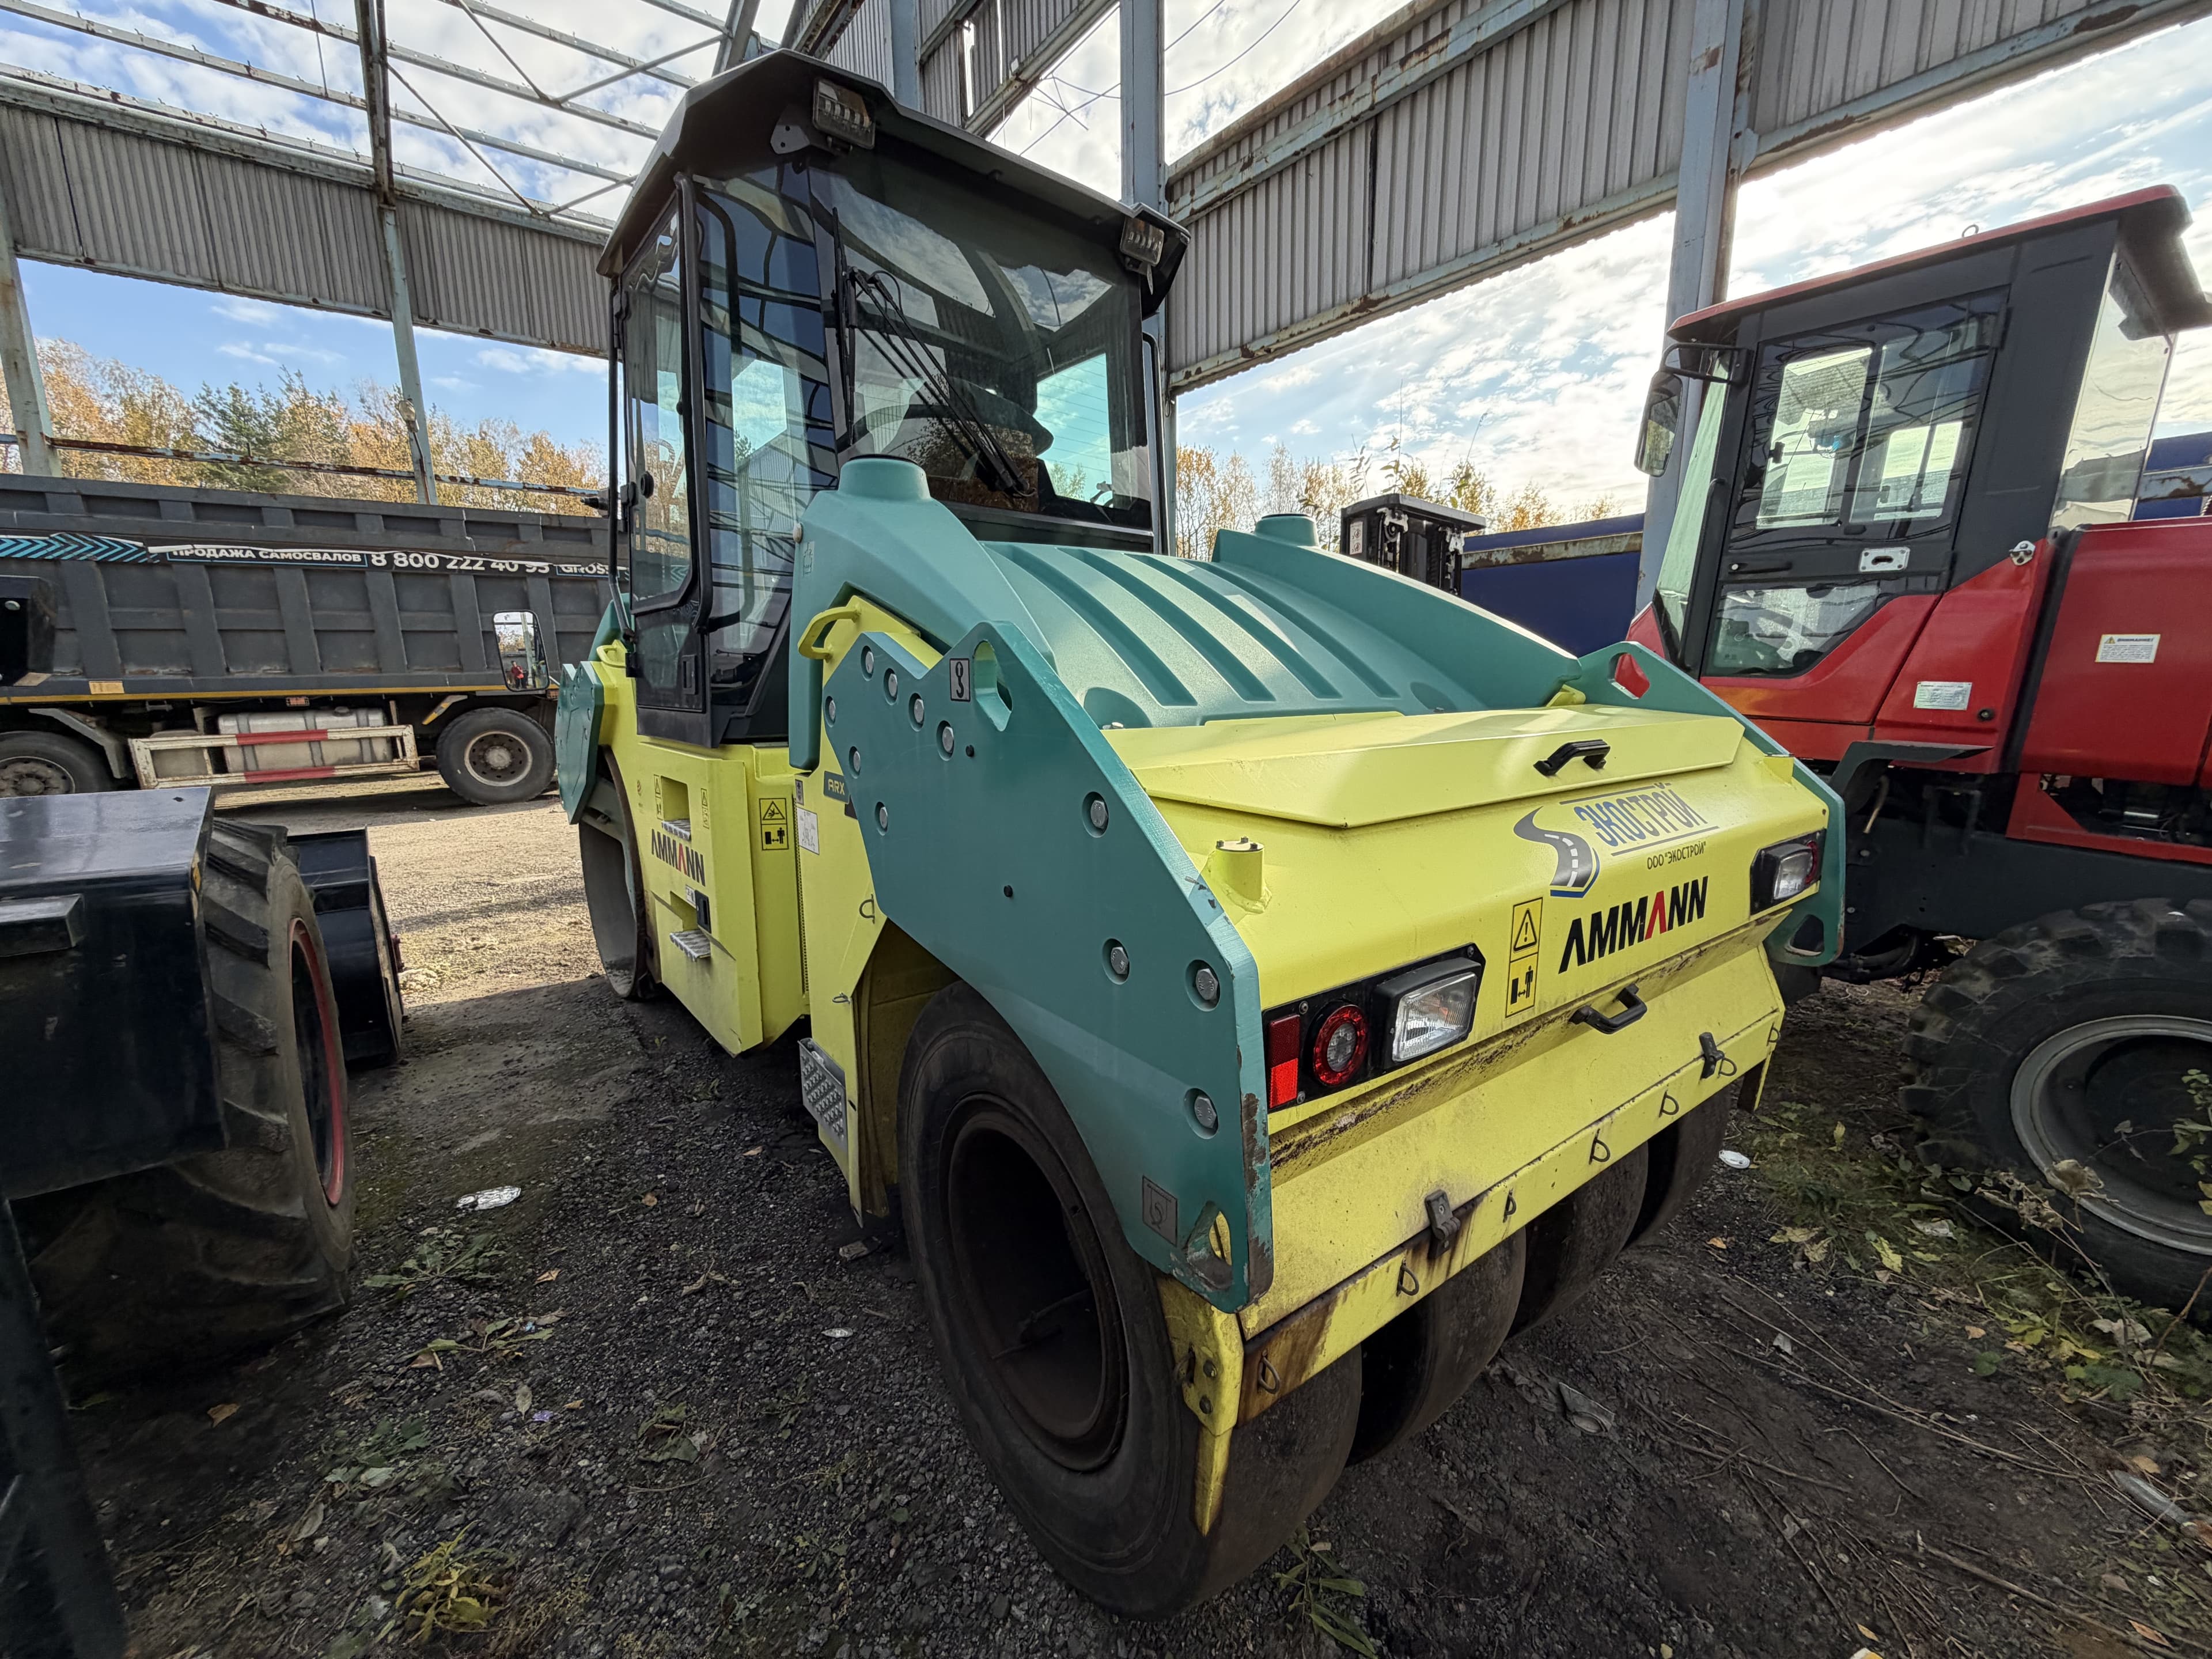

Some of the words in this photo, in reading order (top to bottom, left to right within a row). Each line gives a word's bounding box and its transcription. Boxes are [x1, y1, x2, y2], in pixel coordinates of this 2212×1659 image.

[259, 550, 362, 563] САМОСВАЛОВ
[371, 552, 387, 566] 8
[393, 551, 440, 568] 800
[827, 778, 846, 796] ARX
[1573, 782, 1709, 847] ЭКОСТРОЙ
[651, 828, 706, 887] AMMANN
[1646, 857, 1664, 870] ООО
[1664, 840, 1706, 865] "ЭКОСТРОЙ"
[1558, 875, 1709, 975] AMMANN
